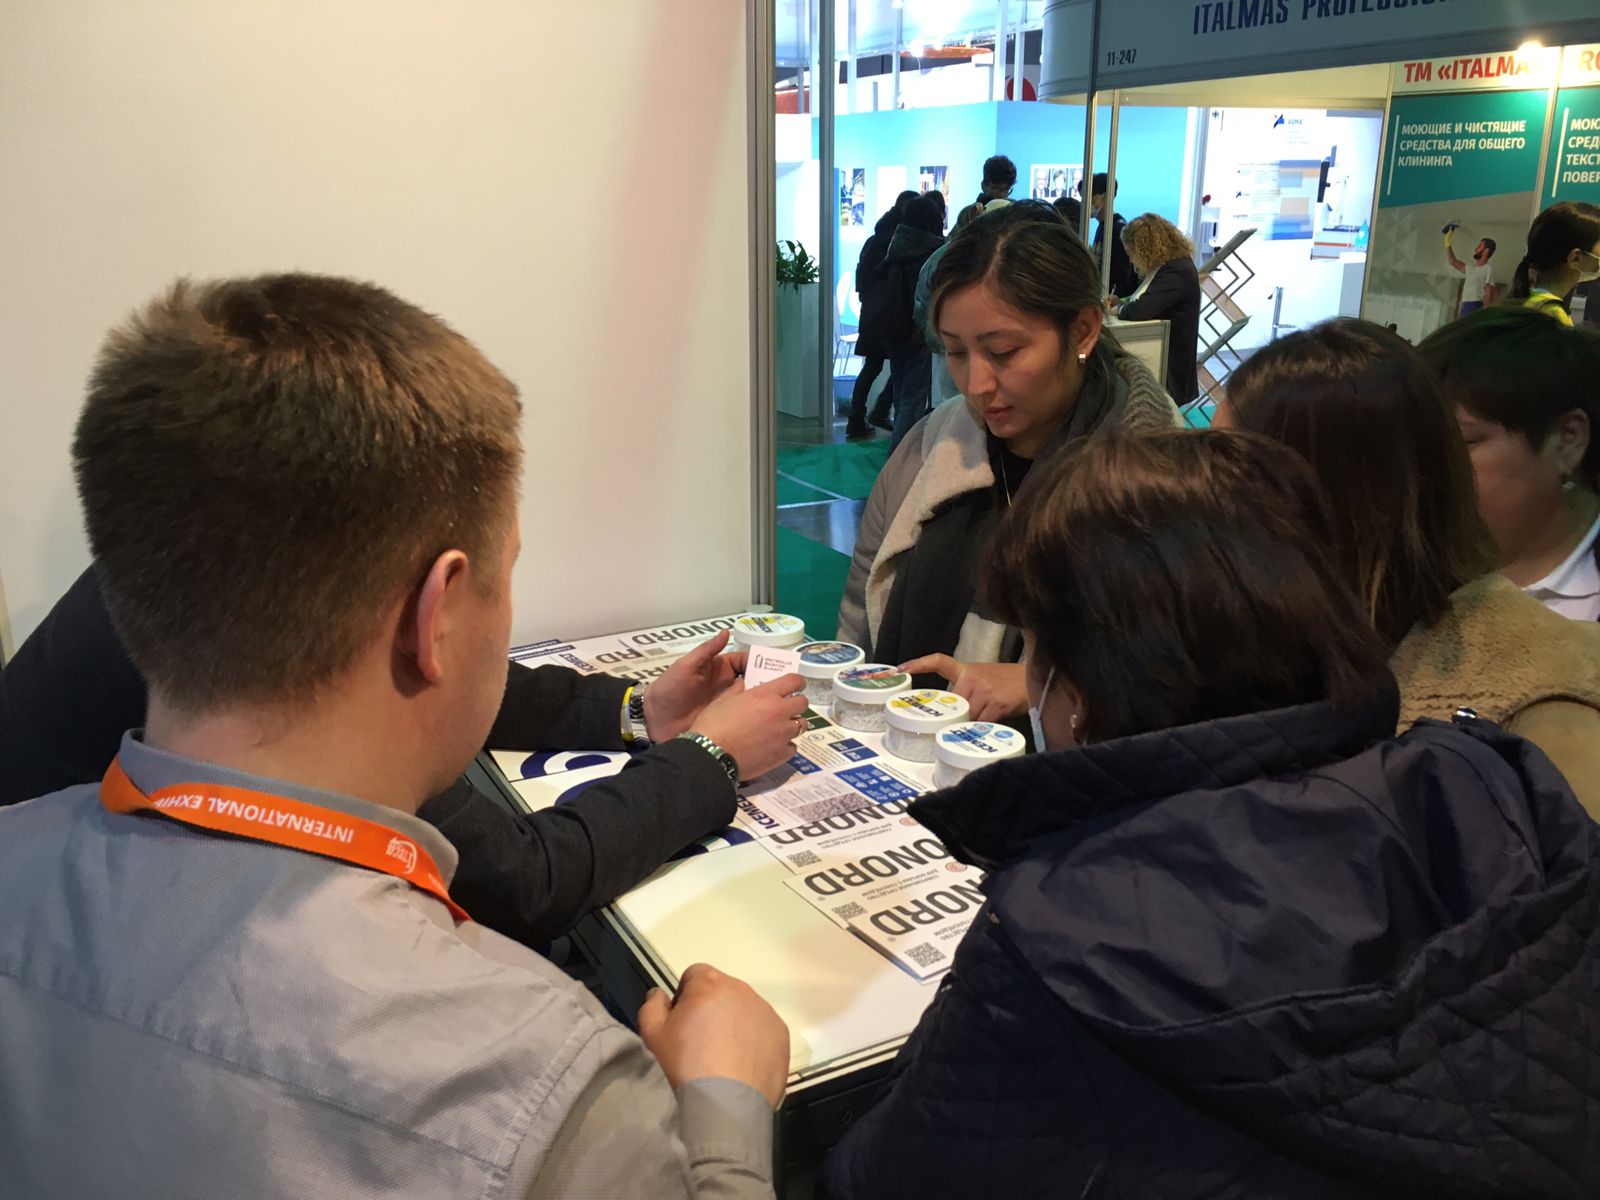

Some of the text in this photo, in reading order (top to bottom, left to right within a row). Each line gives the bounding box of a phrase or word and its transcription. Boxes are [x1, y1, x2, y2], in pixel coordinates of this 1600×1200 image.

[1193, 0, 1289, 35] ITALMAS
[1107, 48, 1137, 66] 11-247
[1401, 120, 1526, 136] МОЮЩИЕ И ЧИСТЯЩИЕ
[1400, 137, 1526, 152] СРЕДСТВА ДЛЯ ОБЩЕГО
[1398, 155, 1453, 167] КЛИНИНГА
[631, 618, 736, 646] ONORD
[207, 796, 354, 844] INTERNATIONAL
